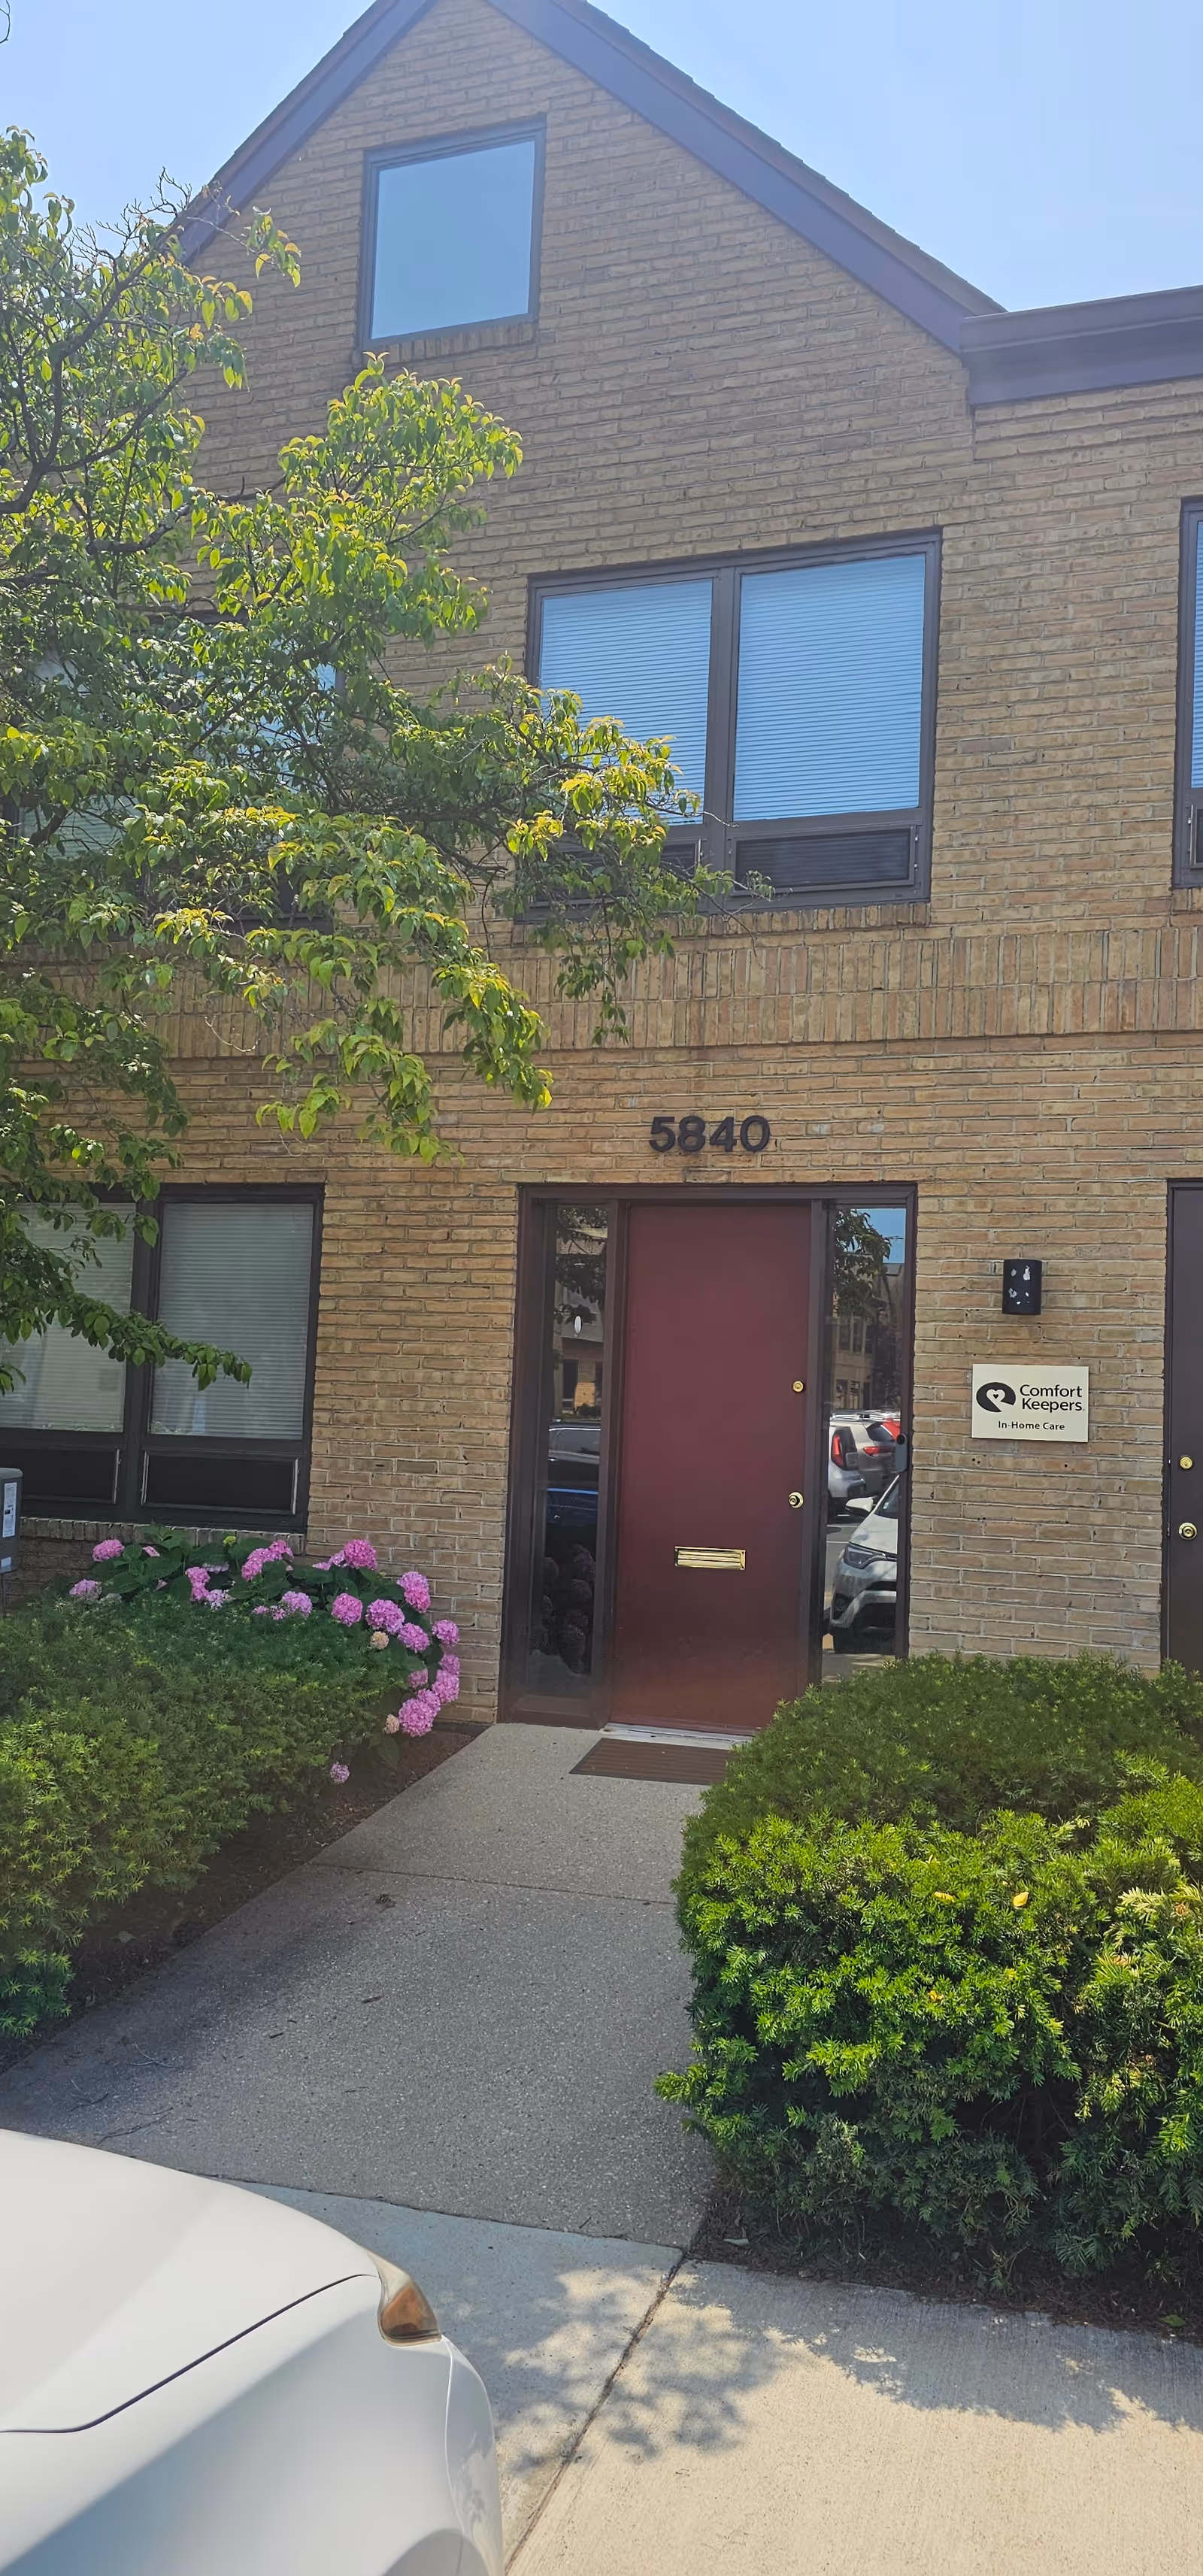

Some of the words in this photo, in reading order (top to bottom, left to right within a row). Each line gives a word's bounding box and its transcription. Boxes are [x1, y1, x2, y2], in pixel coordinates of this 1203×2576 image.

[649, 1114, 771, 1153] 5840
[1020, 1384, 1083, 1398] Comfort
[1022, 1398, 1083, 1413] Keepers
[998, 1420, 1040, 1429] In-Home
[1043, 1422, 1065, 1430] Care
